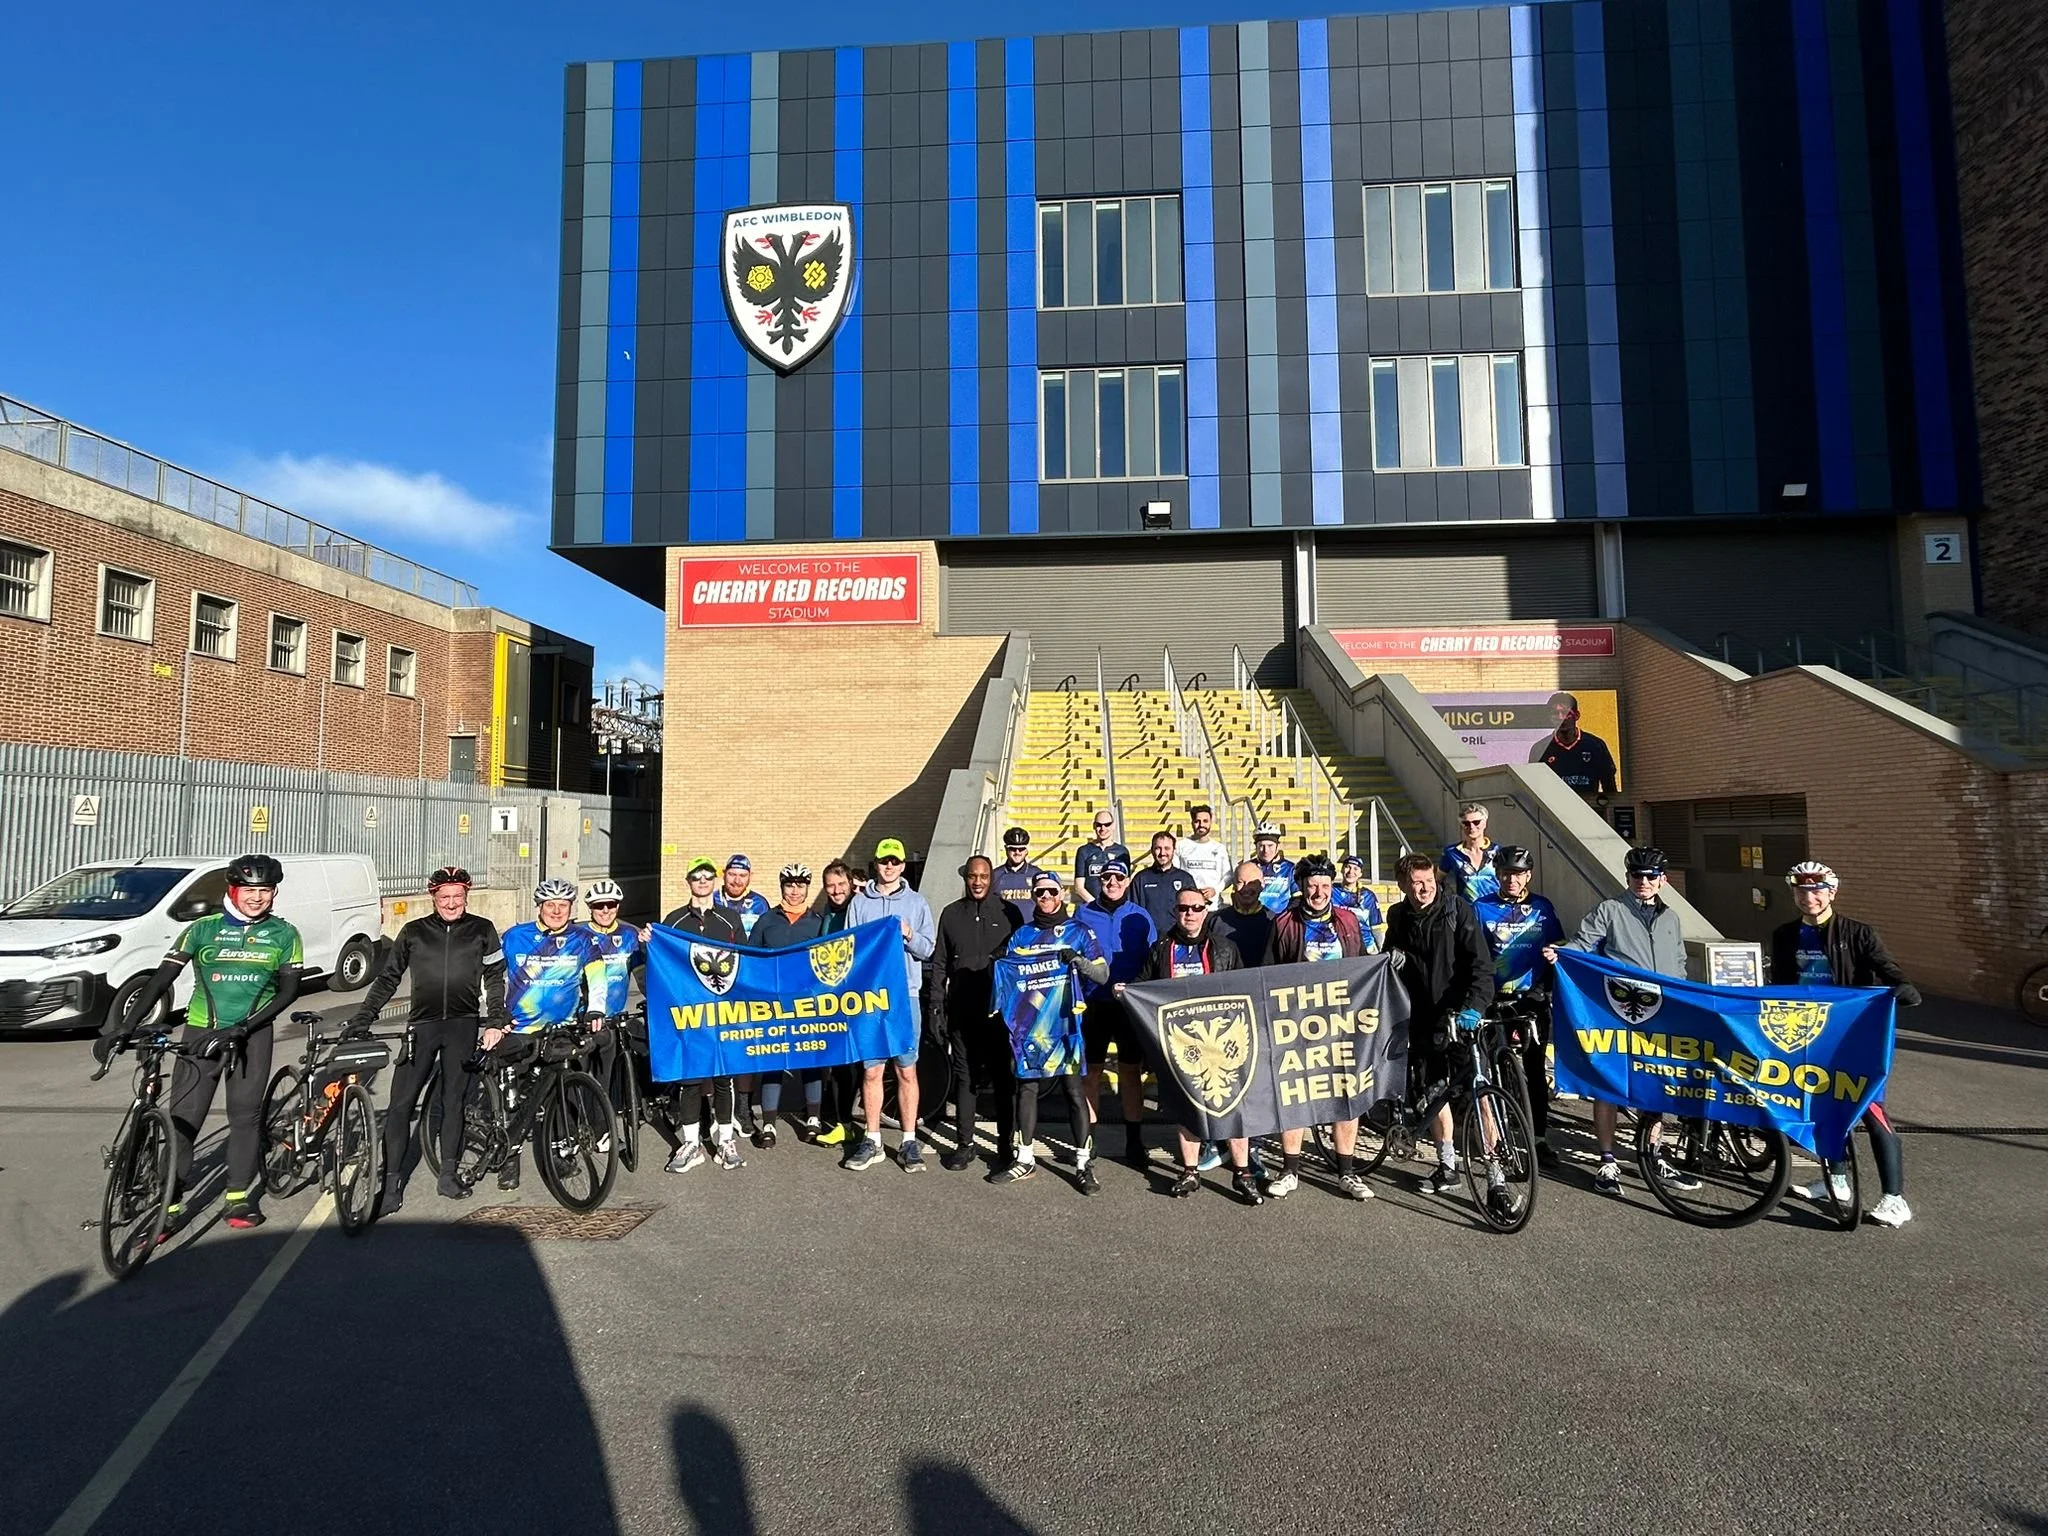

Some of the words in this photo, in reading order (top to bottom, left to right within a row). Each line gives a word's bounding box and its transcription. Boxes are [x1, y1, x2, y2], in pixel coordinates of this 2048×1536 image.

[733, 217, 758, 228] AFC
[762, 212, 842, 224] WIMBLEDON
[1935, 543, 1952, 560] 2
[739, 562, 808, 575] WELCOME
[813, 562, 832, 573] TO
[835, 561, 861, 573] THE
[692, 580, 772, 605] CHERRY
[771, 578, 811, 603] RED
[813, 577, 907, 602] RECORDS
[768, 607, 830, 619] STADIUM
[1384, 641, 1398, 649] TO
[1399, 641, 1417, 649] THE
[1420, 637, 1472, 653] CHERRY
[1473, 636, 1499, 652] RED
[1500, 635, 1562, 652] RECORDS
[1565, 638, 1607, 647] STADIUM
[1488, 711, 1515, 725] UP
[500, 815, 508, 830] 1
[217, 948, 271, 961] Europcar
[1018, 959, 1061, 976] PARKER
[1270, 979, 1351, 1013] THE
[670, 988, 890, 1031] WIMBLEDON
[1166, 1009, 1185, 1019] AFC
[1186, 1002, 1245, 1015] WIMBLEDON
[720, 1028, 764, 1042] PRIDE
[768, 1026, 787, 1037] OF
[791, 1022, 848, 1035] LONDON
[1272, 1008, 1380, 1045] DONS
[746, 1043, 790, 1056] SINCE
[795, 1040, 827, 1051] 1889
[1278, 1041, 1356, 1075] ARE
[1575, 1028, 1869, 1102] WIMBLEDON
[1279, 1064, 1375, 1106] HERE
[1633, 1061, 1688, 1079] PRIDE
[1693, 1068, 1716, 1080] OF
[1721, 1072, 1801, 1110] LODON
[1665, 1084, 1717, 1101] SINCE
